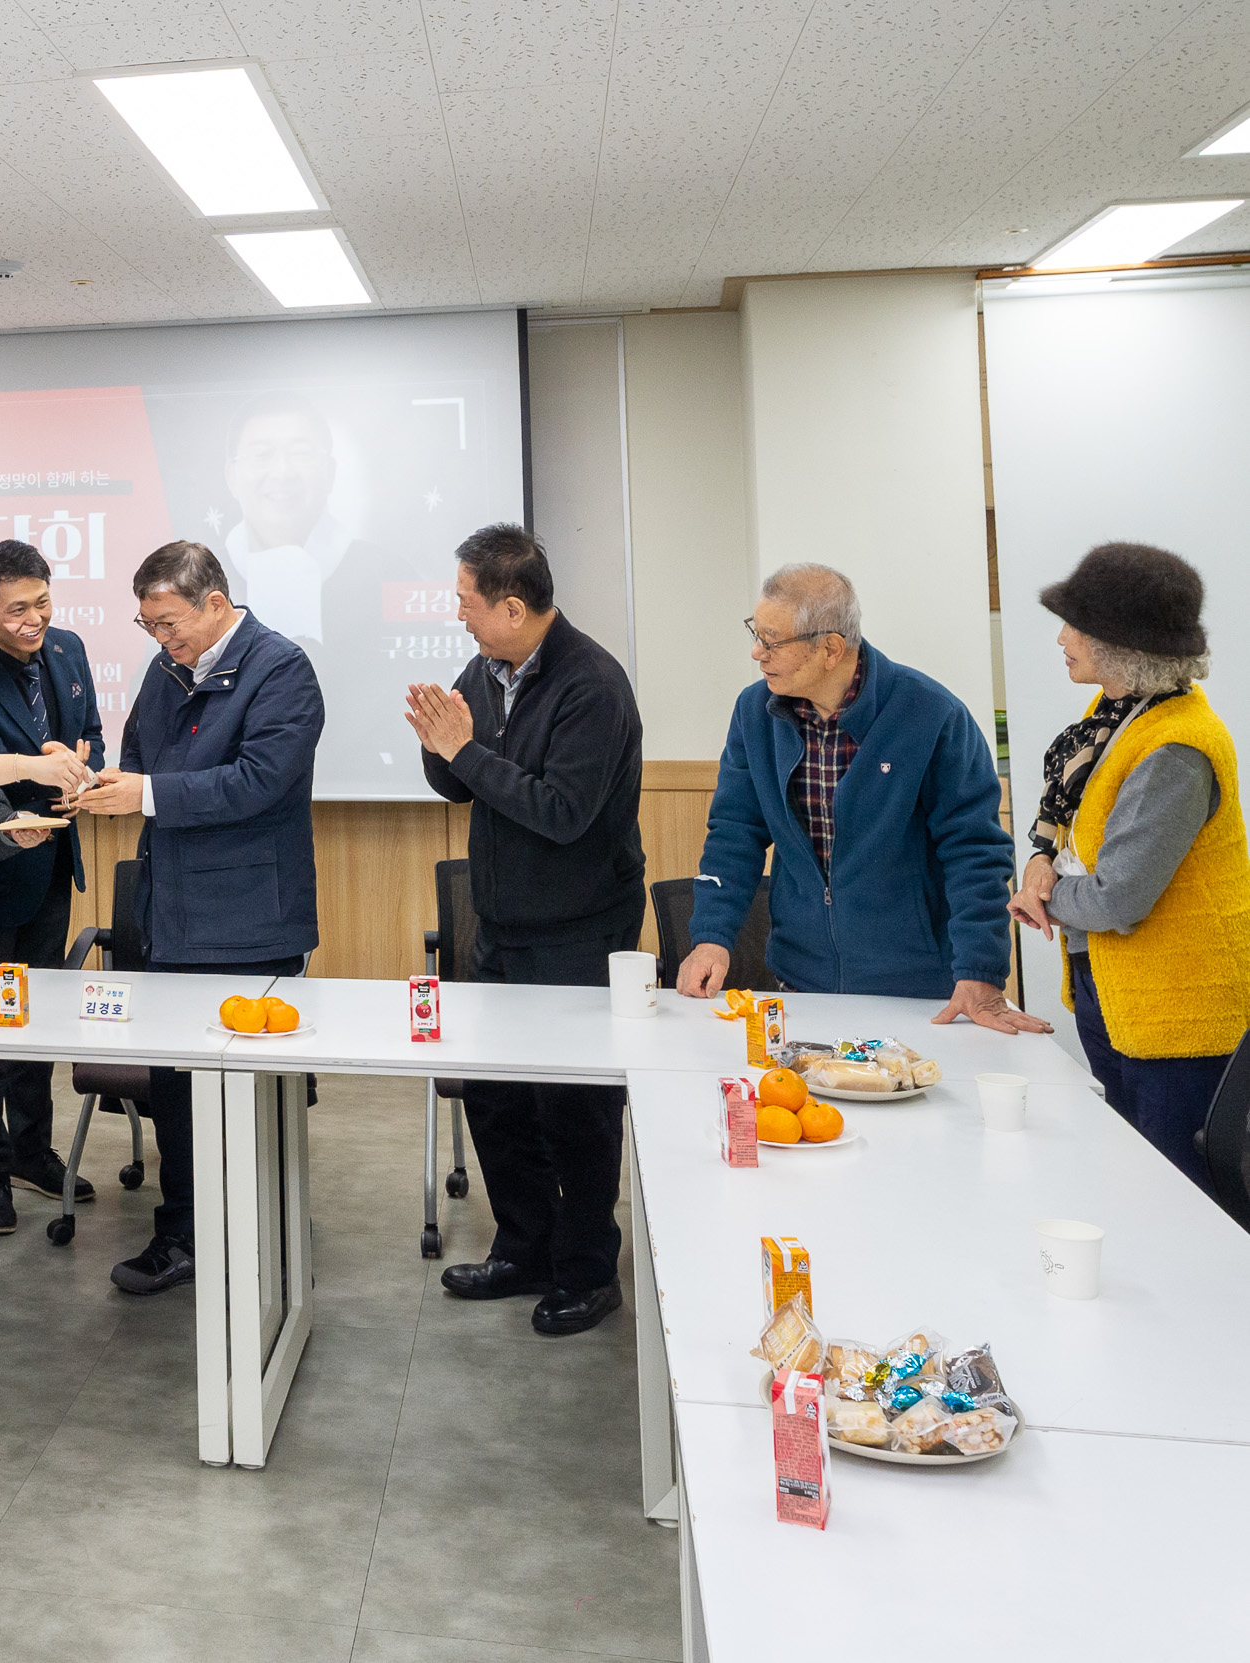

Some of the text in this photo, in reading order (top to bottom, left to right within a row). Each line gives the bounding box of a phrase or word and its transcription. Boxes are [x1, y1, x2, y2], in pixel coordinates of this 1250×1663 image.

[45, 471, 76, 488] 함께
[79, 470, 111, 486] 하는
[405, 589, 460, 614] 김경
[85, 1001, 123, 1015] 김경호
